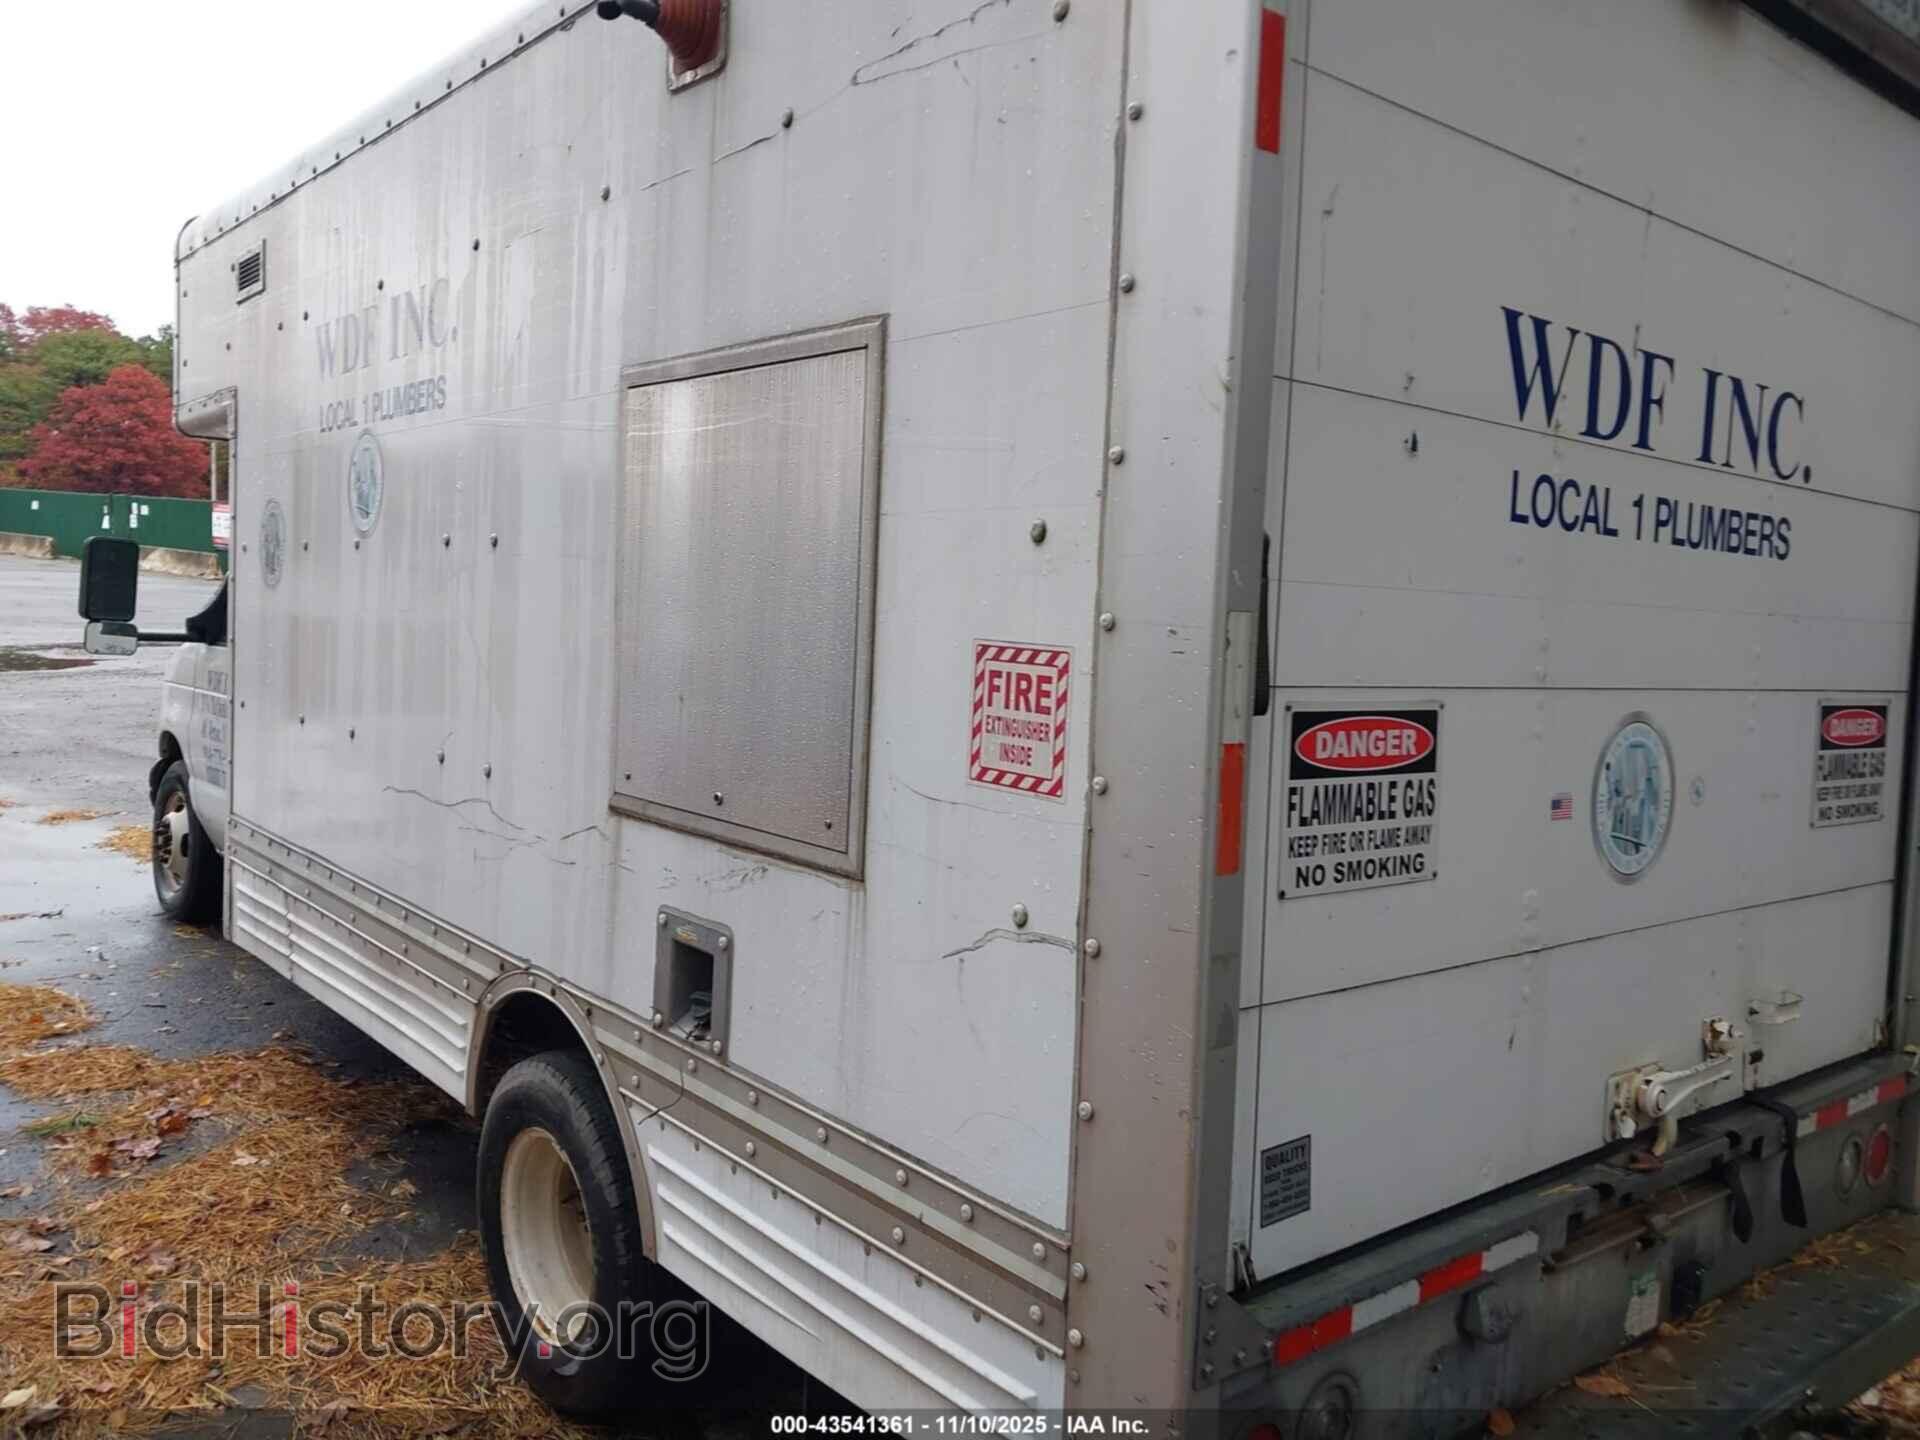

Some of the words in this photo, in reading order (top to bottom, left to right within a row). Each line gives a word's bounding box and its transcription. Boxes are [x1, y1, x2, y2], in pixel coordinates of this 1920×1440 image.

[315, 304, 379, 382] WDF
[388, 277, 458, 361] INC.
[319, 399, 359, 433] LOCAL
[371, 374, 447, 424] PLUMBERS
[1500, 306, 1675, 452] WDF
[1695, 366, 1811, 484] INC.
[1509, 470, 1619, 537] LOCAL
[1632, 493, 1644, 540] 1
[1653, 496, 1791, 561] PLUMBERS
[986, 669, 1054, 716] FIRE
[985, 714, 1051, 743] EXTINGUISHER
[1314, 728, 1418, 759] DANGER
[999, 742, 1033, 767] INSIDE
[1287, 780, 1397, 828] FLAMMABLE
[1402, 778, 1436, 818] GAS
[1288, 834, 1318, 859] KEEP
[1321, 832, 1346, 855] FIRE
[1350, 830, 1365, 852] OR
[1368, 827, 1401, 850] FLAME
[1403, 824, 1433, 847] AWAY
[1295, 864, 1326, 889] NO
[1333, 853, 1425, 884] SMOKING
